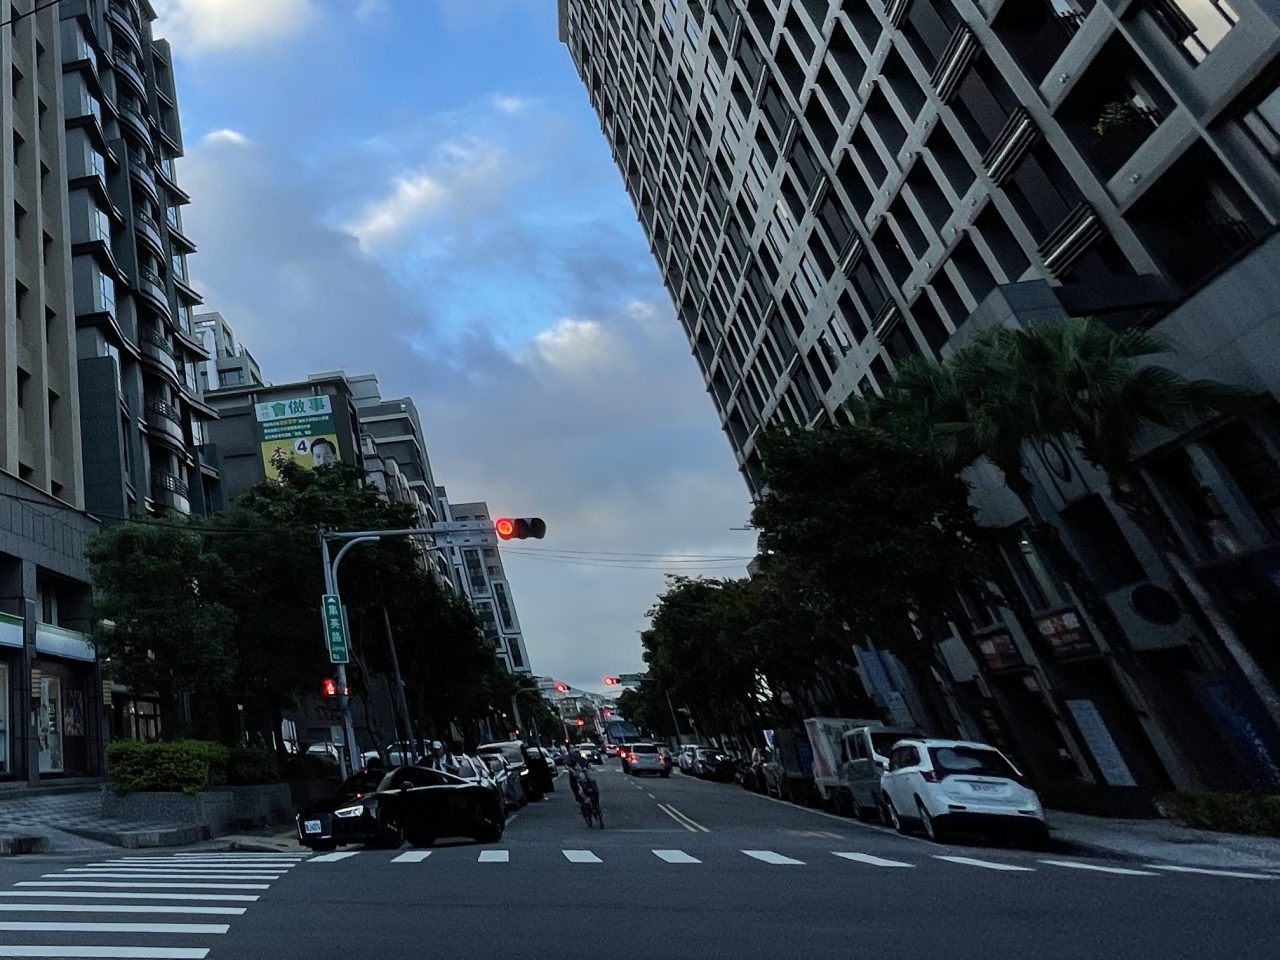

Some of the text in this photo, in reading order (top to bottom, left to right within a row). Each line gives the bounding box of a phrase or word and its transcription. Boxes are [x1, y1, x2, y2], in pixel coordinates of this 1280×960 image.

[271, 398, 325, 416] 會做事
[297, 440, 307, 452] 4
[328, 604, 342, 642] 集英路
